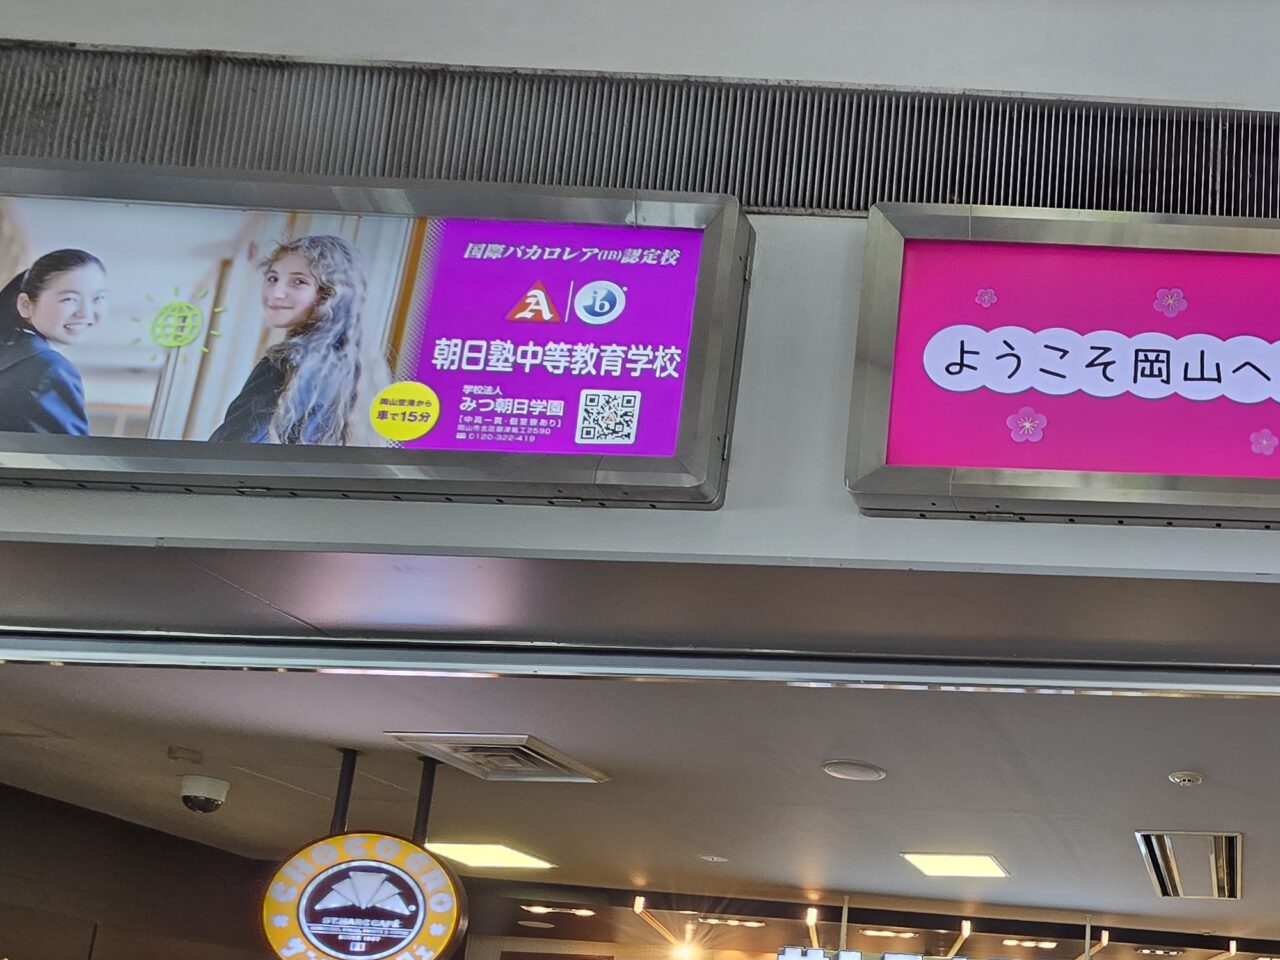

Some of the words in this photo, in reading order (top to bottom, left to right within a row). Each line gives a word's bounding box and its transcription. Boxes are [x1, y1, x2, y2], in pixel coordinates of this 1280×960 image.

[464, 242, 681, 266] 国際バカロレア(IB)認定校
[431, 337, 682, 378] 朝日塾中等教育学校
[376, 410, 431, 422] 車で15分
[459, 396, 564, 416] みつ朝日学園
